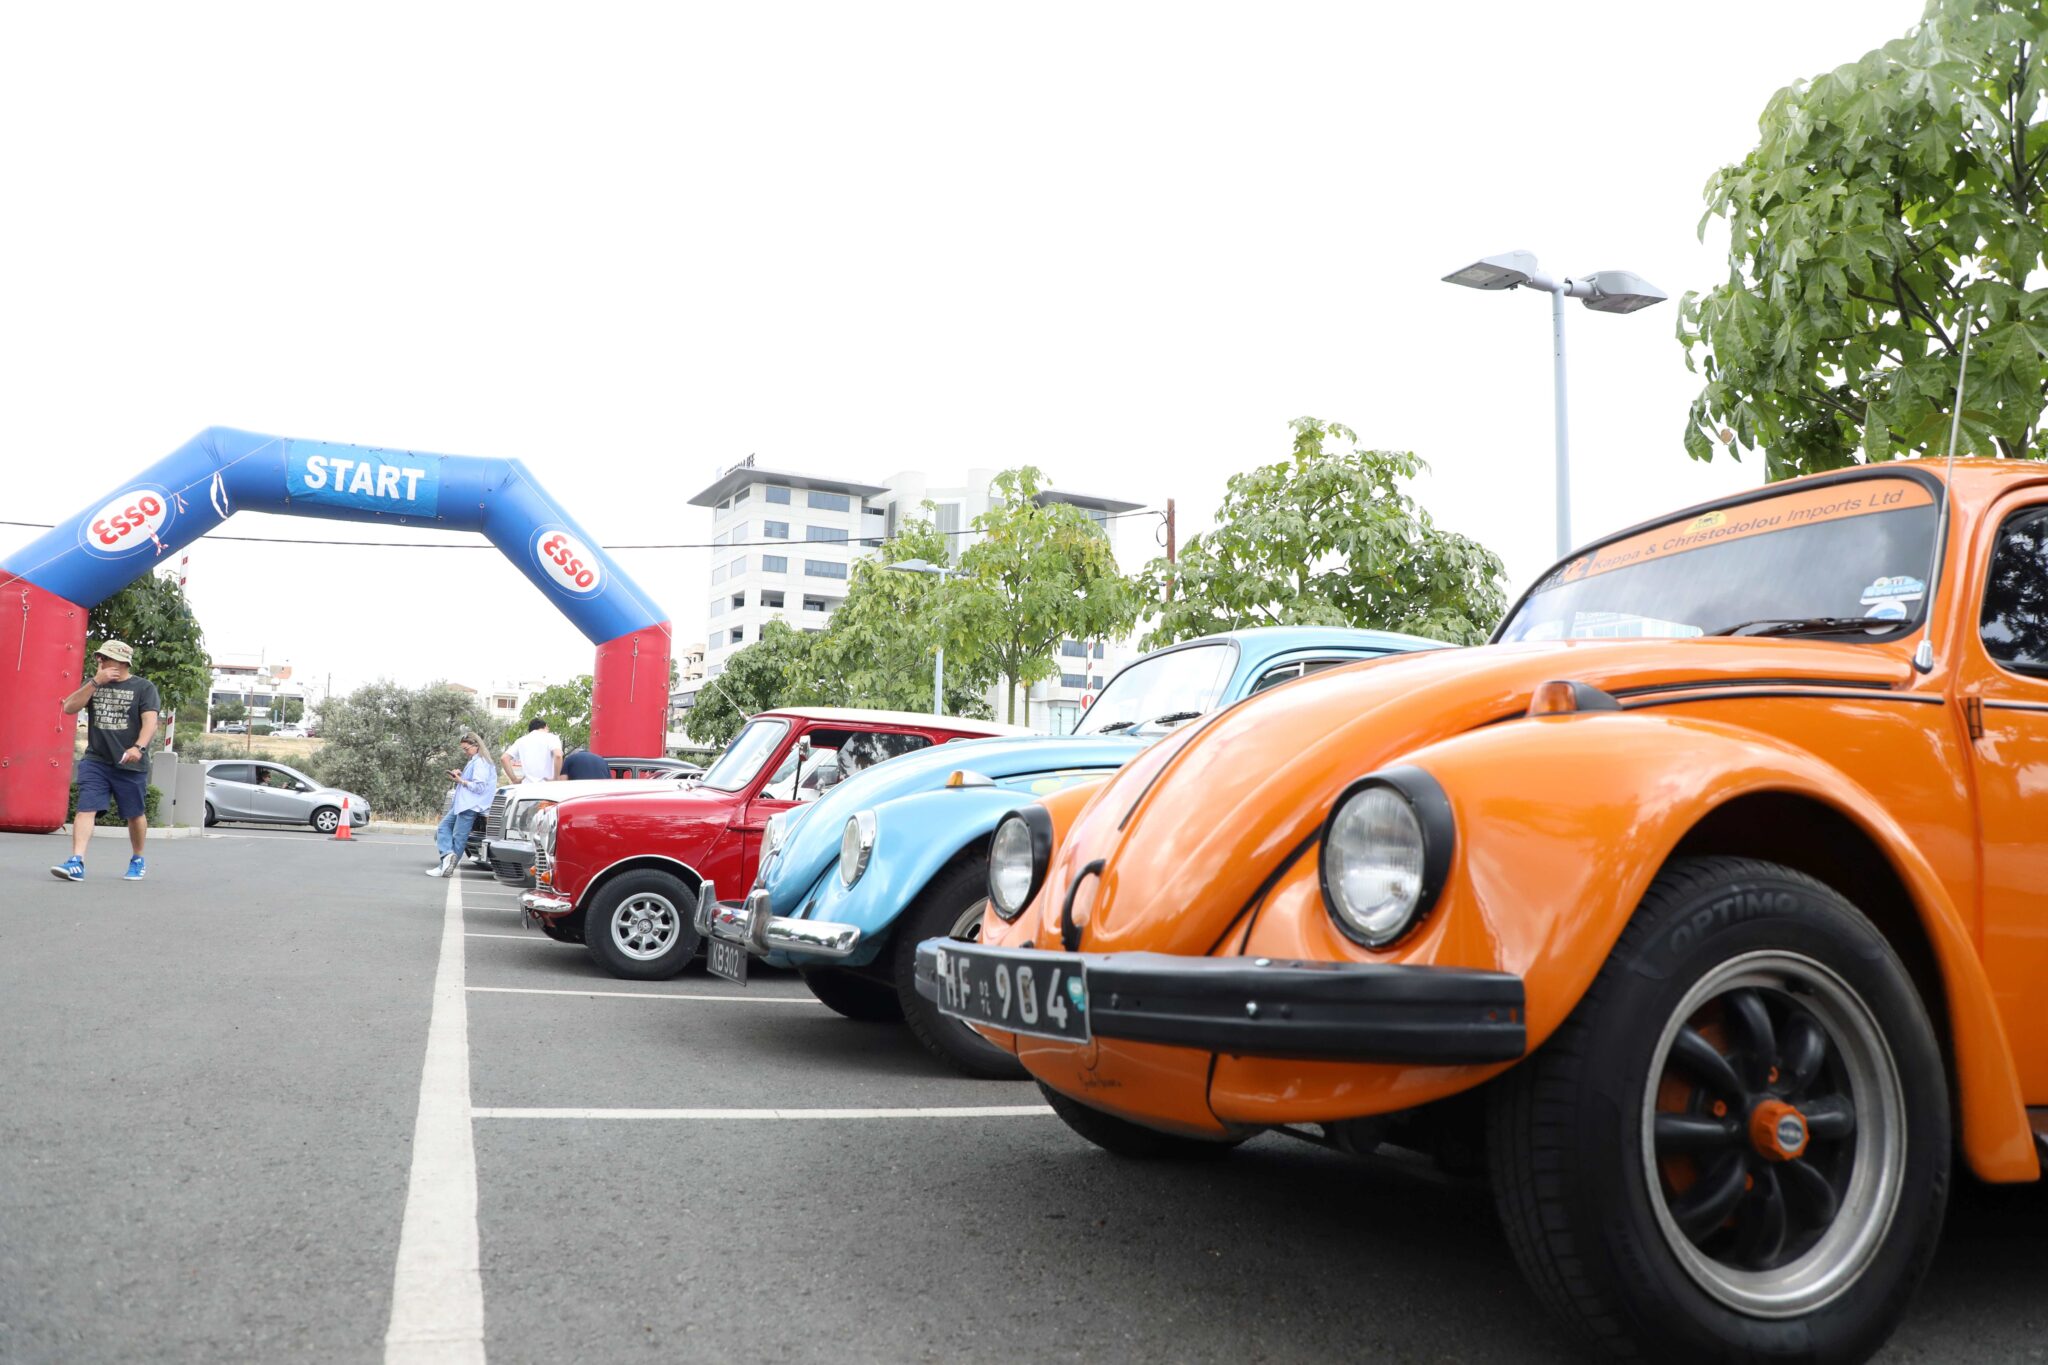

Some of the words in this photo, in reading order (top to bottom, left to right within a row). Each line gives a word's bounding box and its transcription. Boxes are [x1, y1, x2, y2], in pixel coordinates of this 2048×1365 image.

[303, 455, 426, 501] START
[1591, 550, 1641, 570] Kappa
[1644, 543, 1657, 556] &
[1662, 515, 1782, 551] Christodolou
[1786, 498, 1862, 521] Imports
[1868, 489, 1904, 506] Ltd
[1669, 891, 1799, 954] OPTIMO
[945, 955, 970, 1010] HF
[996, 963, 1068, 1029] 904
